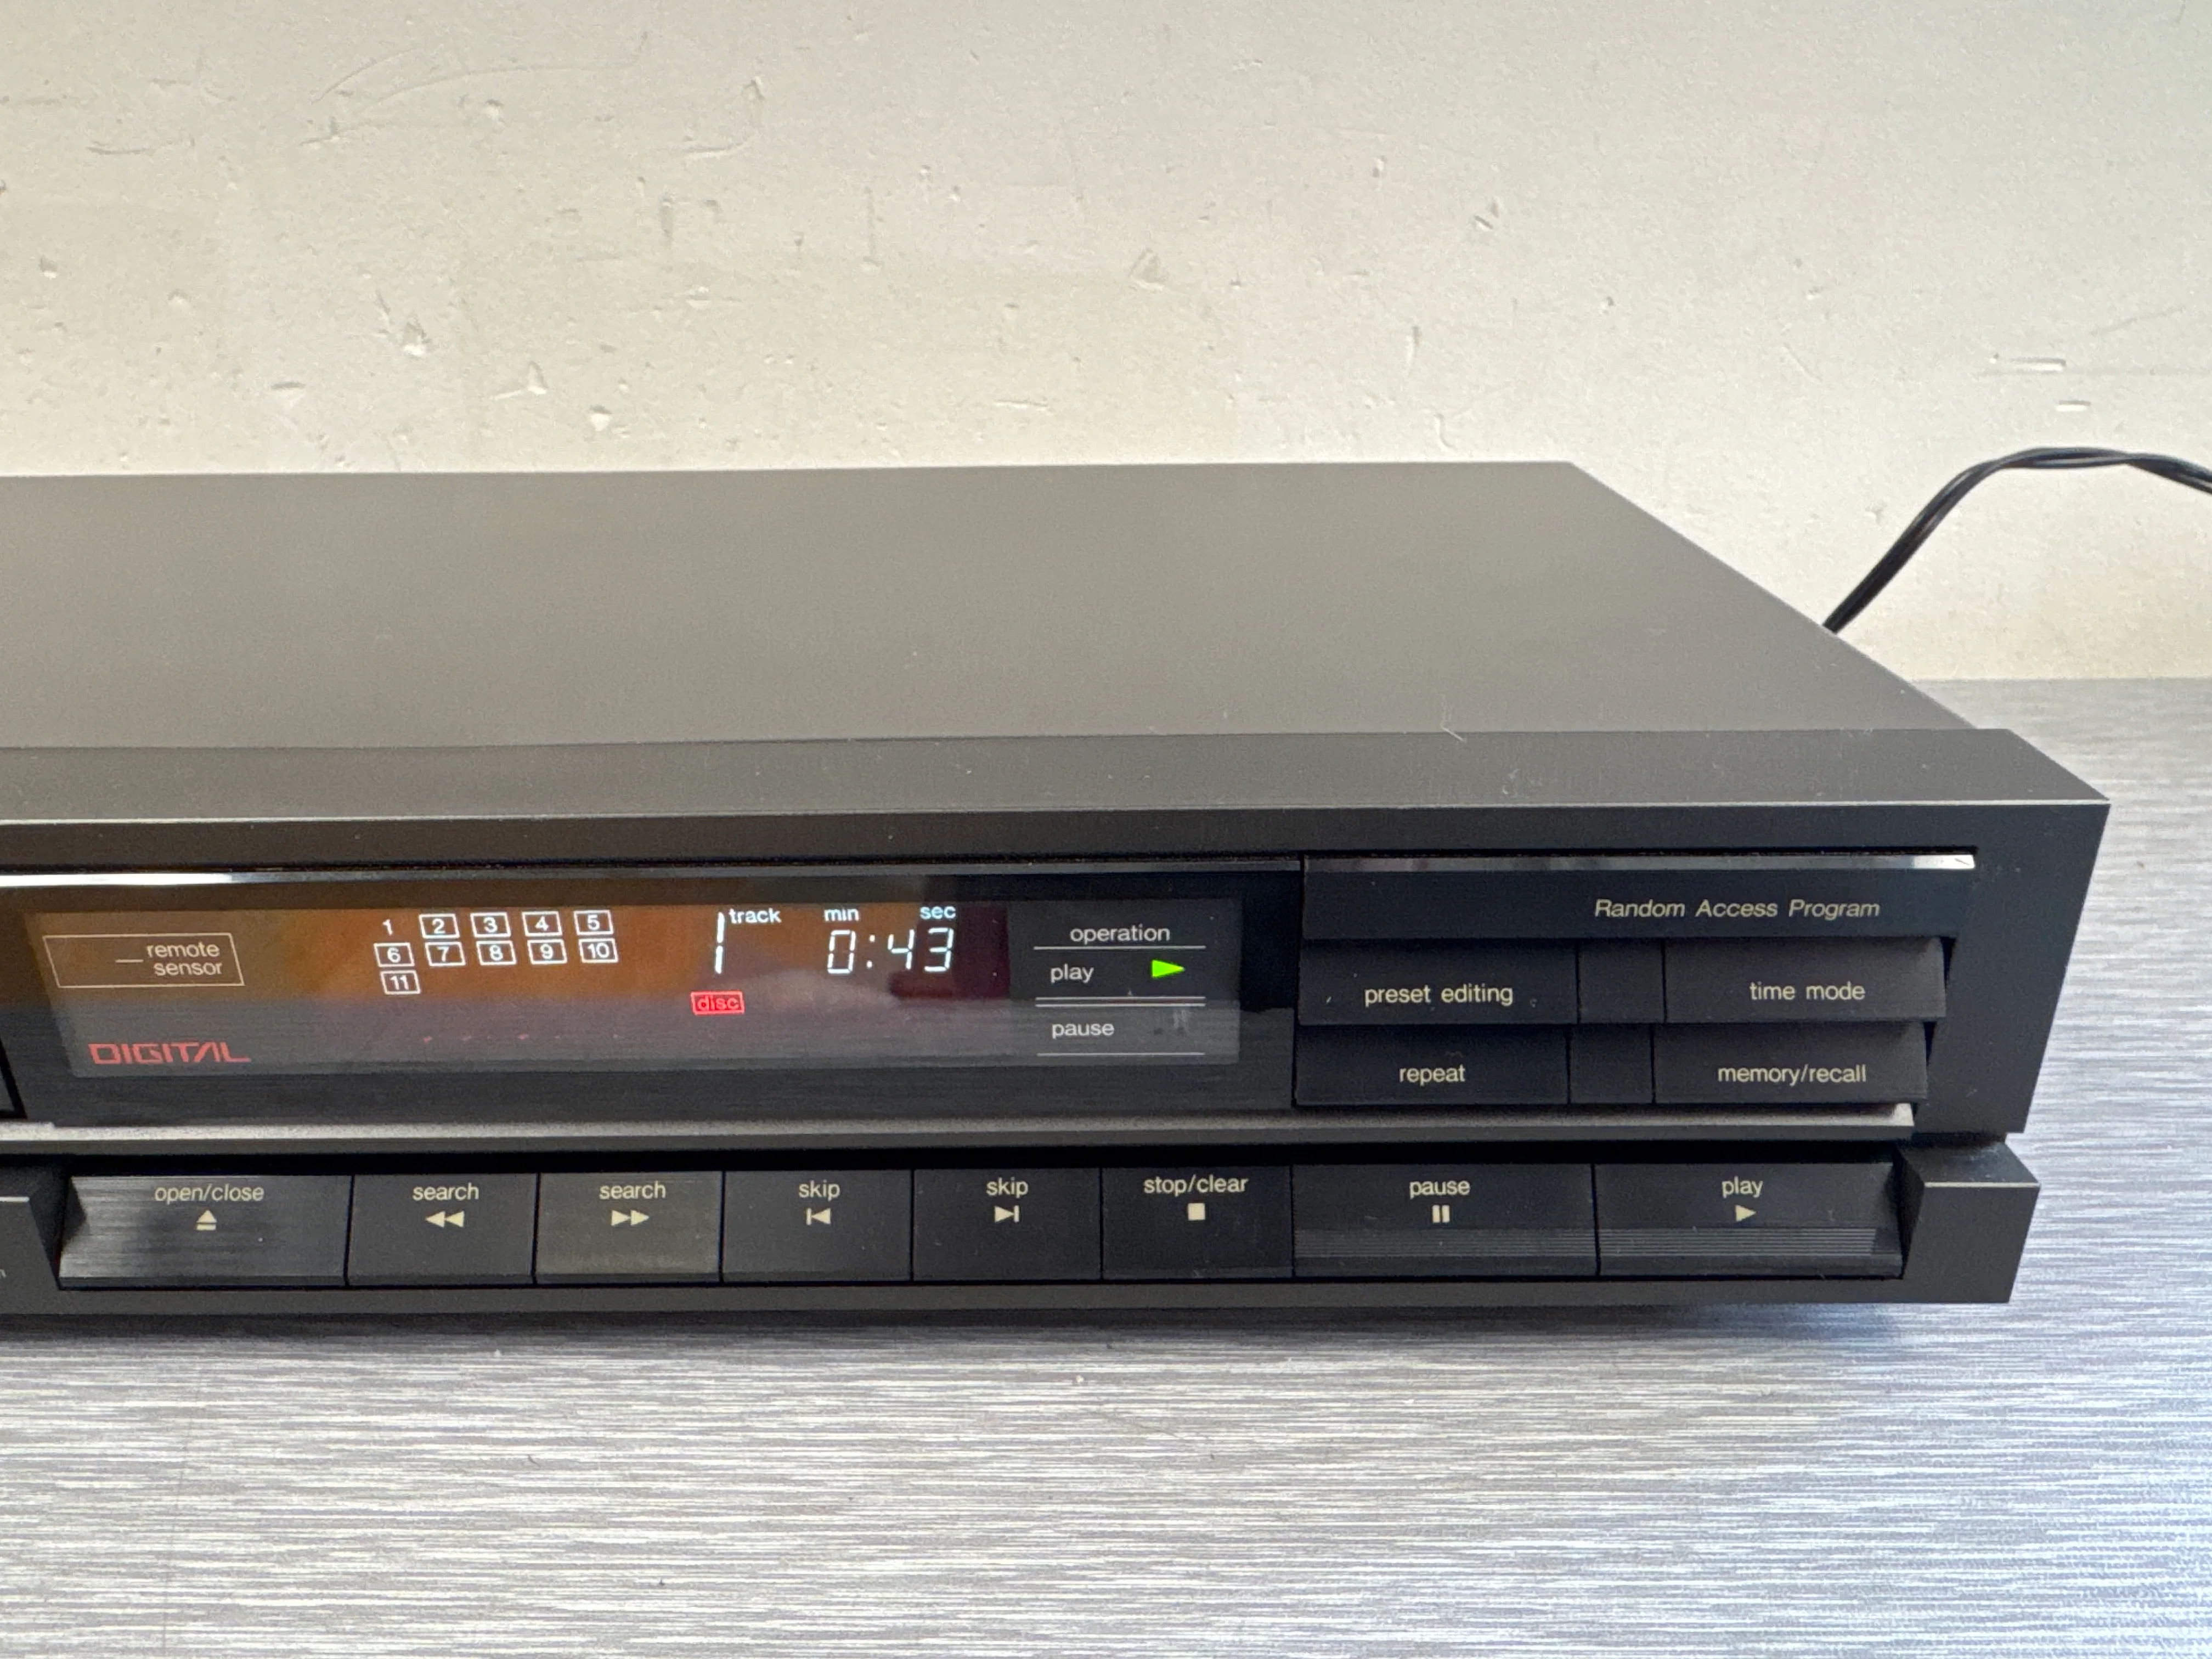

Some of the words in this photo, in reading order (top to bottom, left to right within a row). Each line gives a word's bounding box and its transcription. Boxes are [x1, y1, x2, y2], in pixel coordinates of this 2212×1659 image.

[729, 907, 782, 924] track
[824, 907, 860, 922] min
[920, 906, 956, 919] sec
[1594, 899, 1685, 917] Random
[1695, 899, 1778, 917] Access
[1788, 899, 1880, 921] Program
[382, 919, 393, 936] 1
[432, 918, 445, 934] 2
[483, 916, 498, 934] 3
[535, 916, 549, 931] 4
[587, 914, 600, 930] 5
[1070, 924, 1171, 945] operation
[146, 941, 220, 958] remote
[387, 947, 400, 963] 6
[438, 947, 449, 962] 7
[489, 945, 503, 961] 8
[540, 944, 554, 960] 9
[587, 943, 610, 958] 10
[714, 912, 725, 974] 1
[827, 927, 954, 974] 0:43
[154, 962, 223, 976] sensor
[1050, 963, 1094, 983] play
[390, 975, 409, 990] 11
[1749, 982, 1795, 1001] time
[1806, 981, 1865, 1001] mode
[697, 995, 740, 1011] disc
[1365, 985, 1431, 1007] preset
[1441, 983, 1513, 1006] editing
[1052, 1023, 1115, 1039] pause
[89, 1042, 247, 1064] DIGITAL
[1399, 1064, 1466, 1086] repeat
[1718, 1064, 1866, 1086] memory/recall
[155, 1183, 264, 1205] open/close
[413, 1182, 479, 1201] search
[599, 1181, 666, 1199] search
[799, 1181, 840, 1201] skip
[986, 1177, 1028, 1198] skip
[1144, 1174, 1248, 1197] stop/clear
[1409, 1181, 1470, 1199] pause
[1722, 1176, 1763, 1198] play
